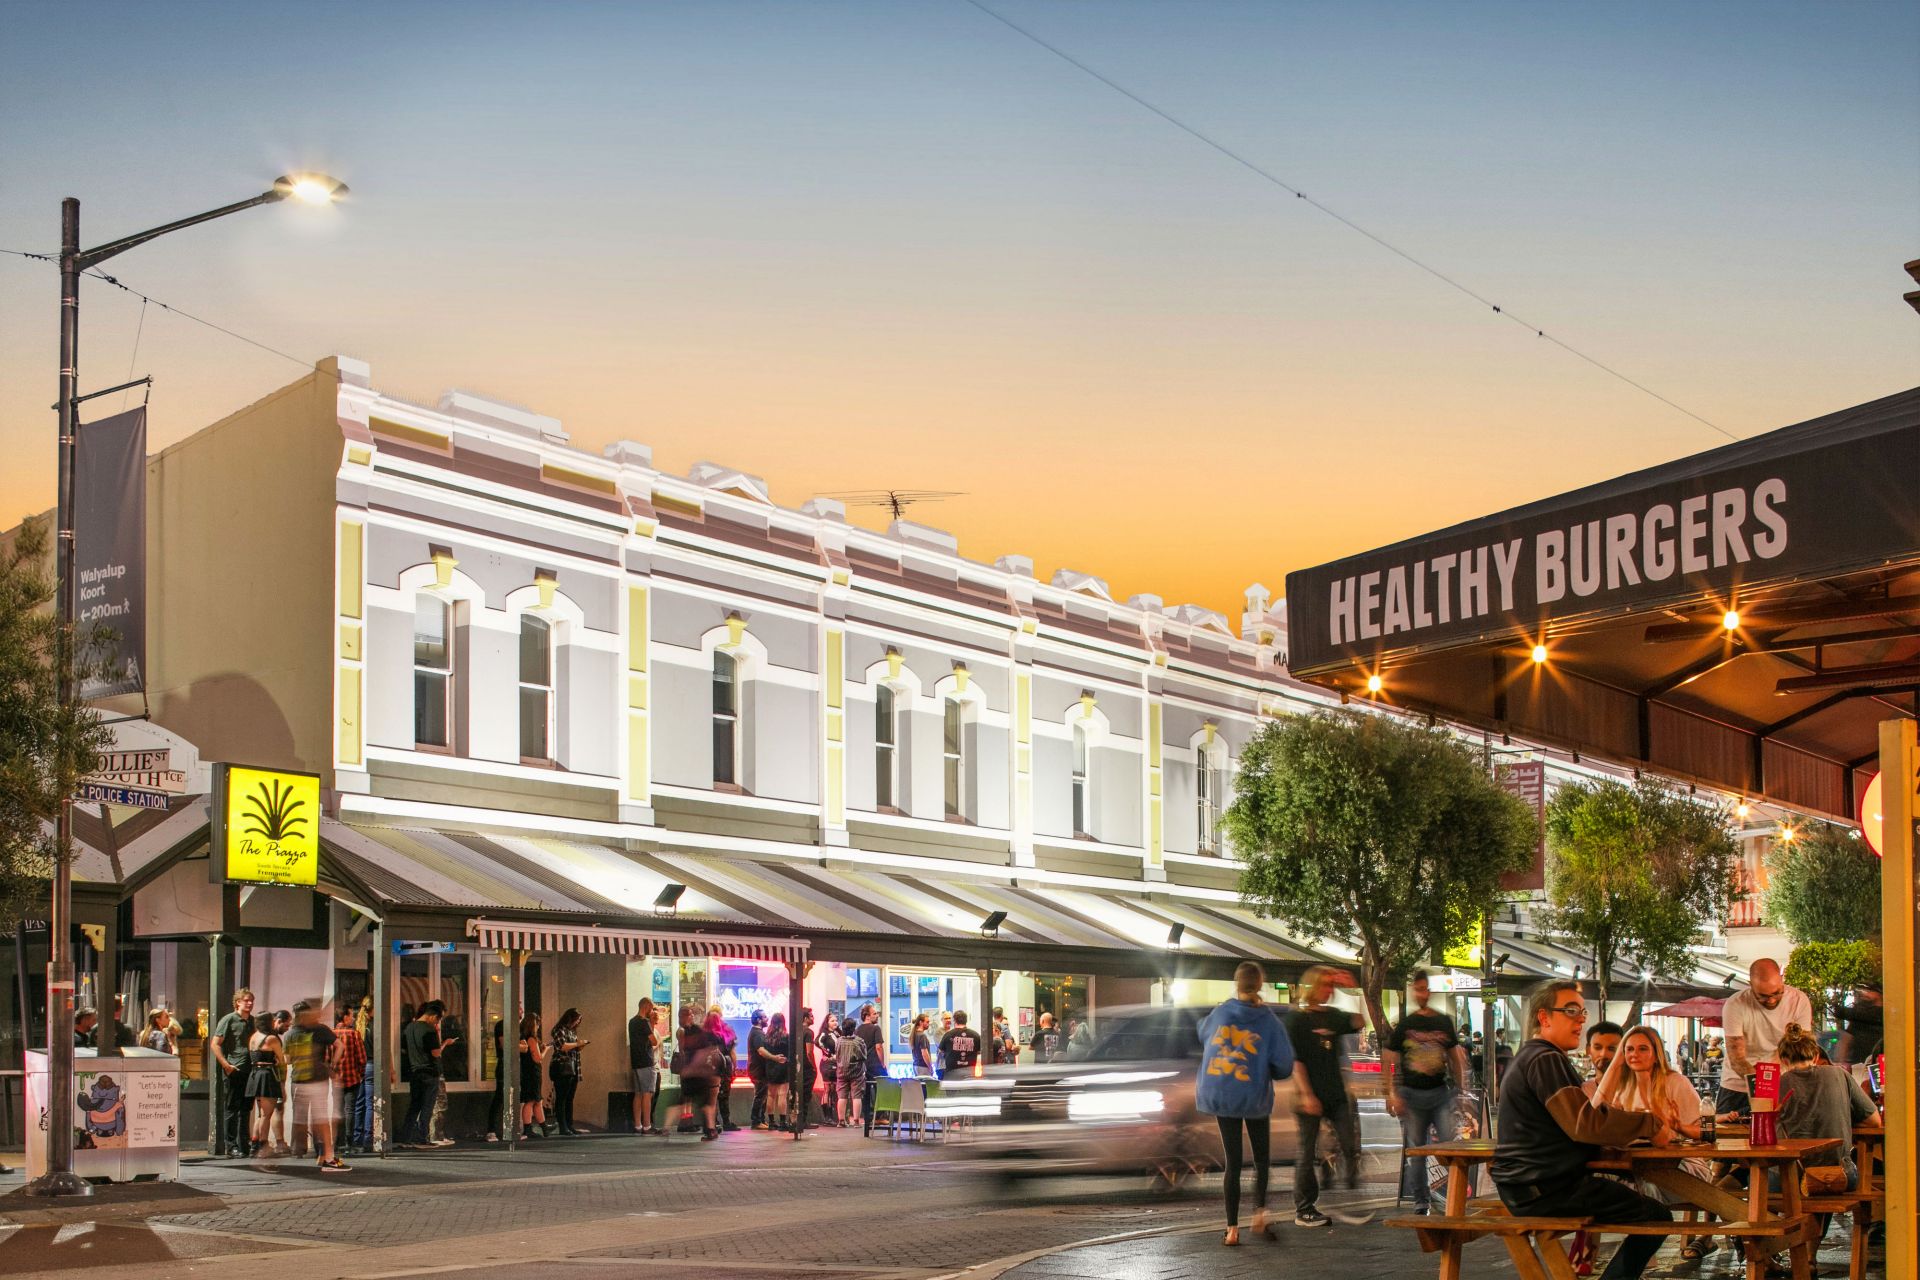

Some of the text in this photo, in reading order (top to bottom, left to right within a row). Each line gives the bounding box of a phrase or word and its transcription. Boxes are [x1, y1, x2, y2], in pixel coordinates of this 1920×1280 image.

[1330, 478, 1787, 646] HEALTHY BURGERS
[81, 564, 125, 583] Walyalup
[81, 584, 105, 600] Koort
[91, 603, 122, 620] 200m
[98, 752, 167, 772] OLLIE ST
[165, 772, 183, 783] TCE
[89, 786, 167, 809] POLICE STATION
[240, 840, 307, 865] The Piazza
[158, 1081, 173, 1090] help
[147, 1092, 163, 1100] keep
[138, 1101, 172, 1110] Fremantle
